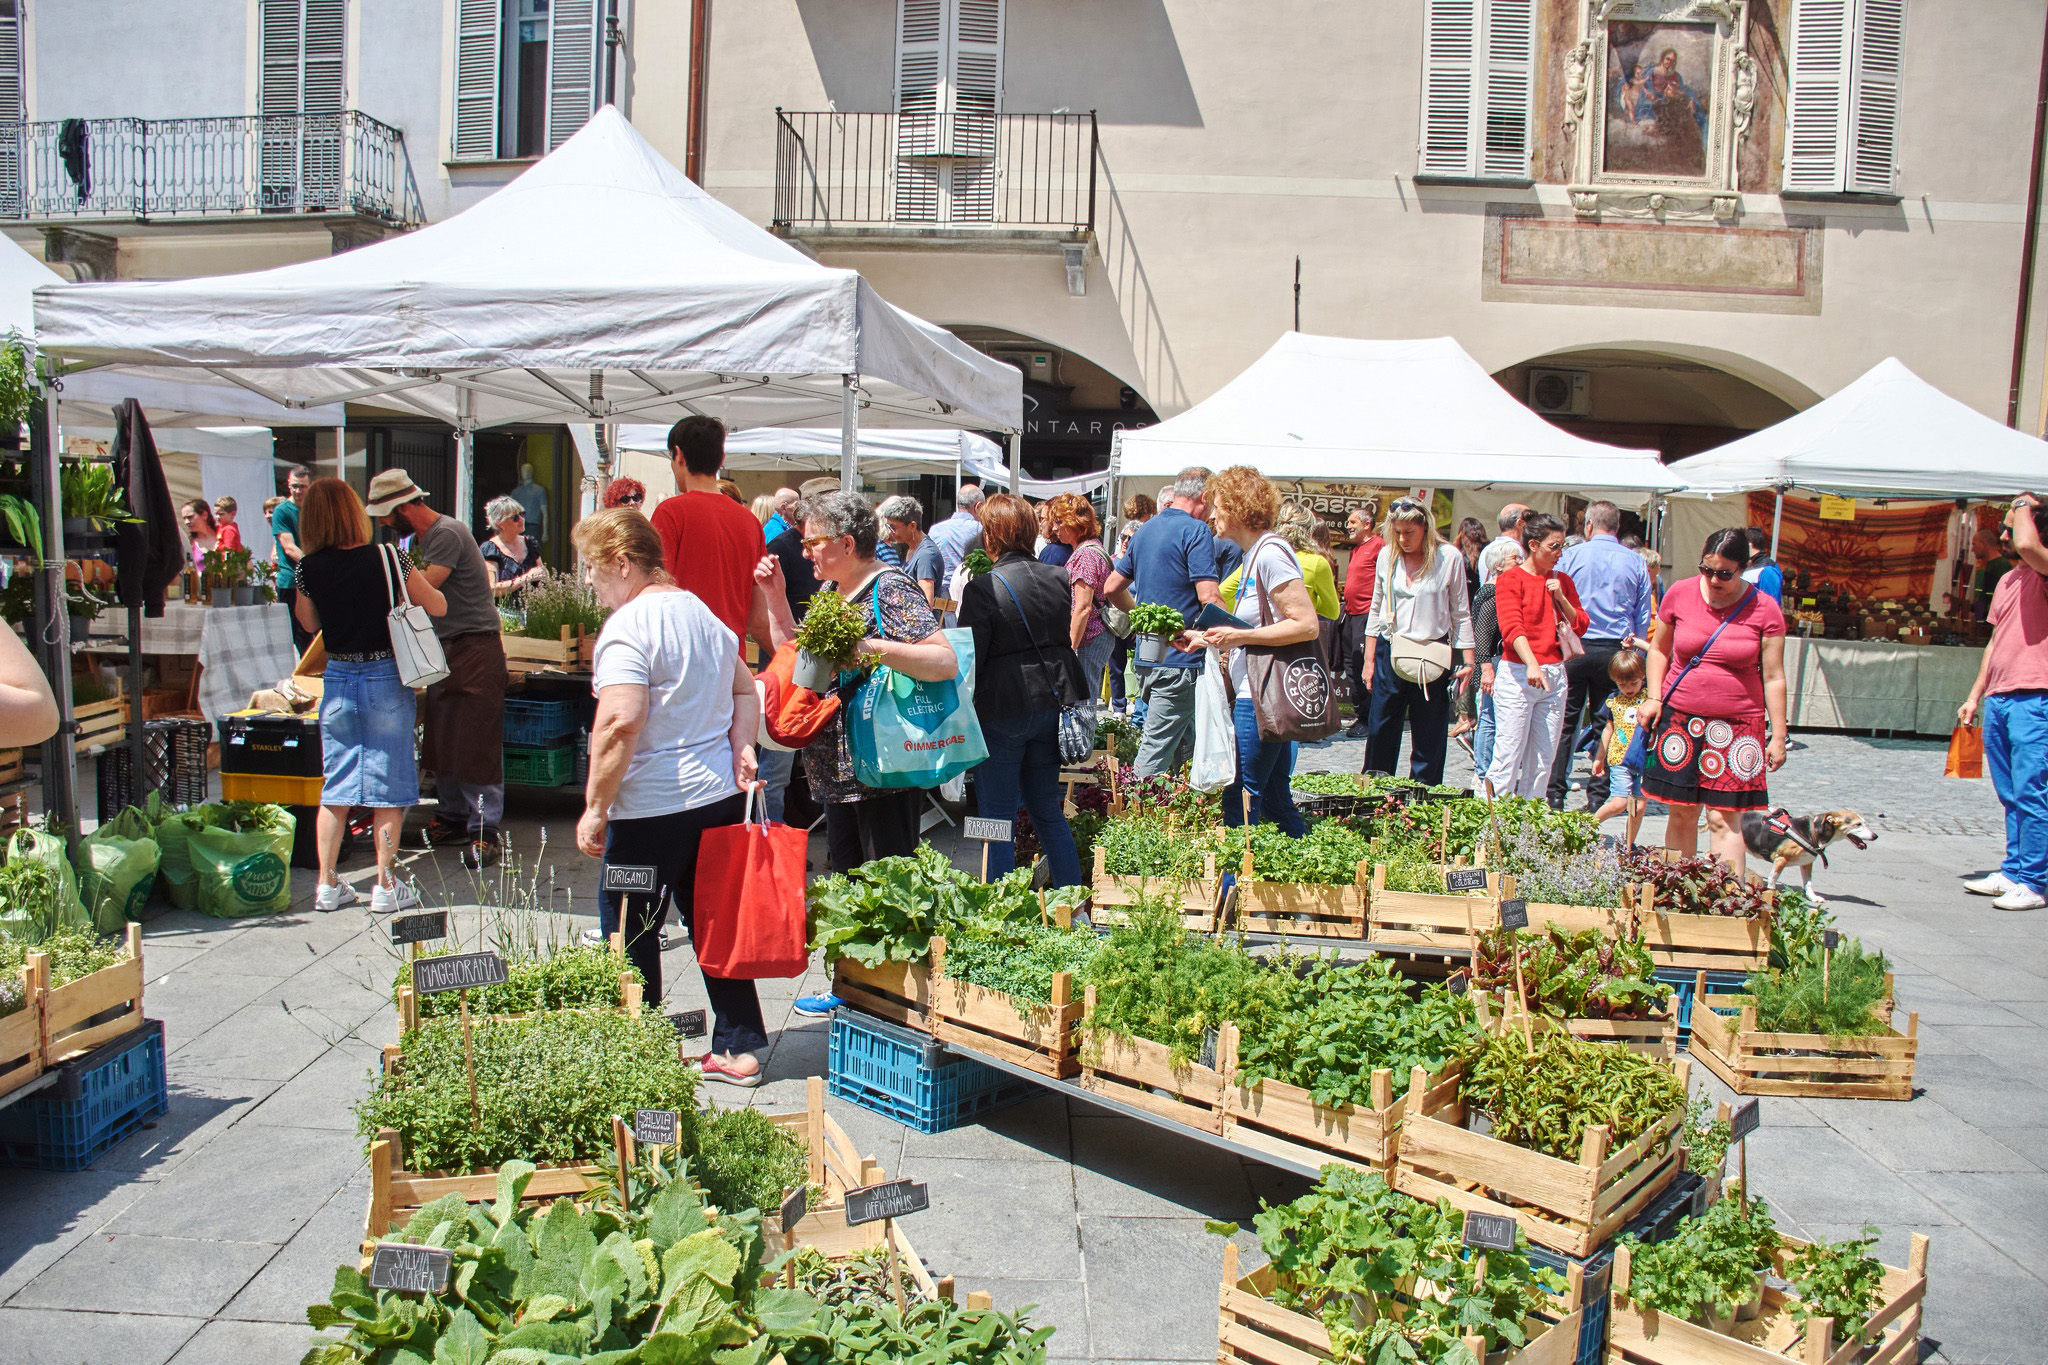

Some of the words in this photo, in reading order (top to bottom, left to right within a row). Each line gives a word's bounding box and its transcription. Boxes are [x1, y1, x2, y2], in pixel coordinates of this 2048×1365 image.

[251, 743, 283, 752] STANLEY
[967, 819, 1008, 839] RABARBARO
[610, 869, 649, 885] ORIGANO
[420, 957, 498, 988] MAGGIORANA
[639, 1111, 671, 1125] SALVIA
[865, 1195, 914, 1219] OFFICINALIS
[1476, 1218, 1503, 1240] MALVA
[394, 1250, 430, 1274] SALVIA
[387, 1268, 435, 1292] SCLAREA
